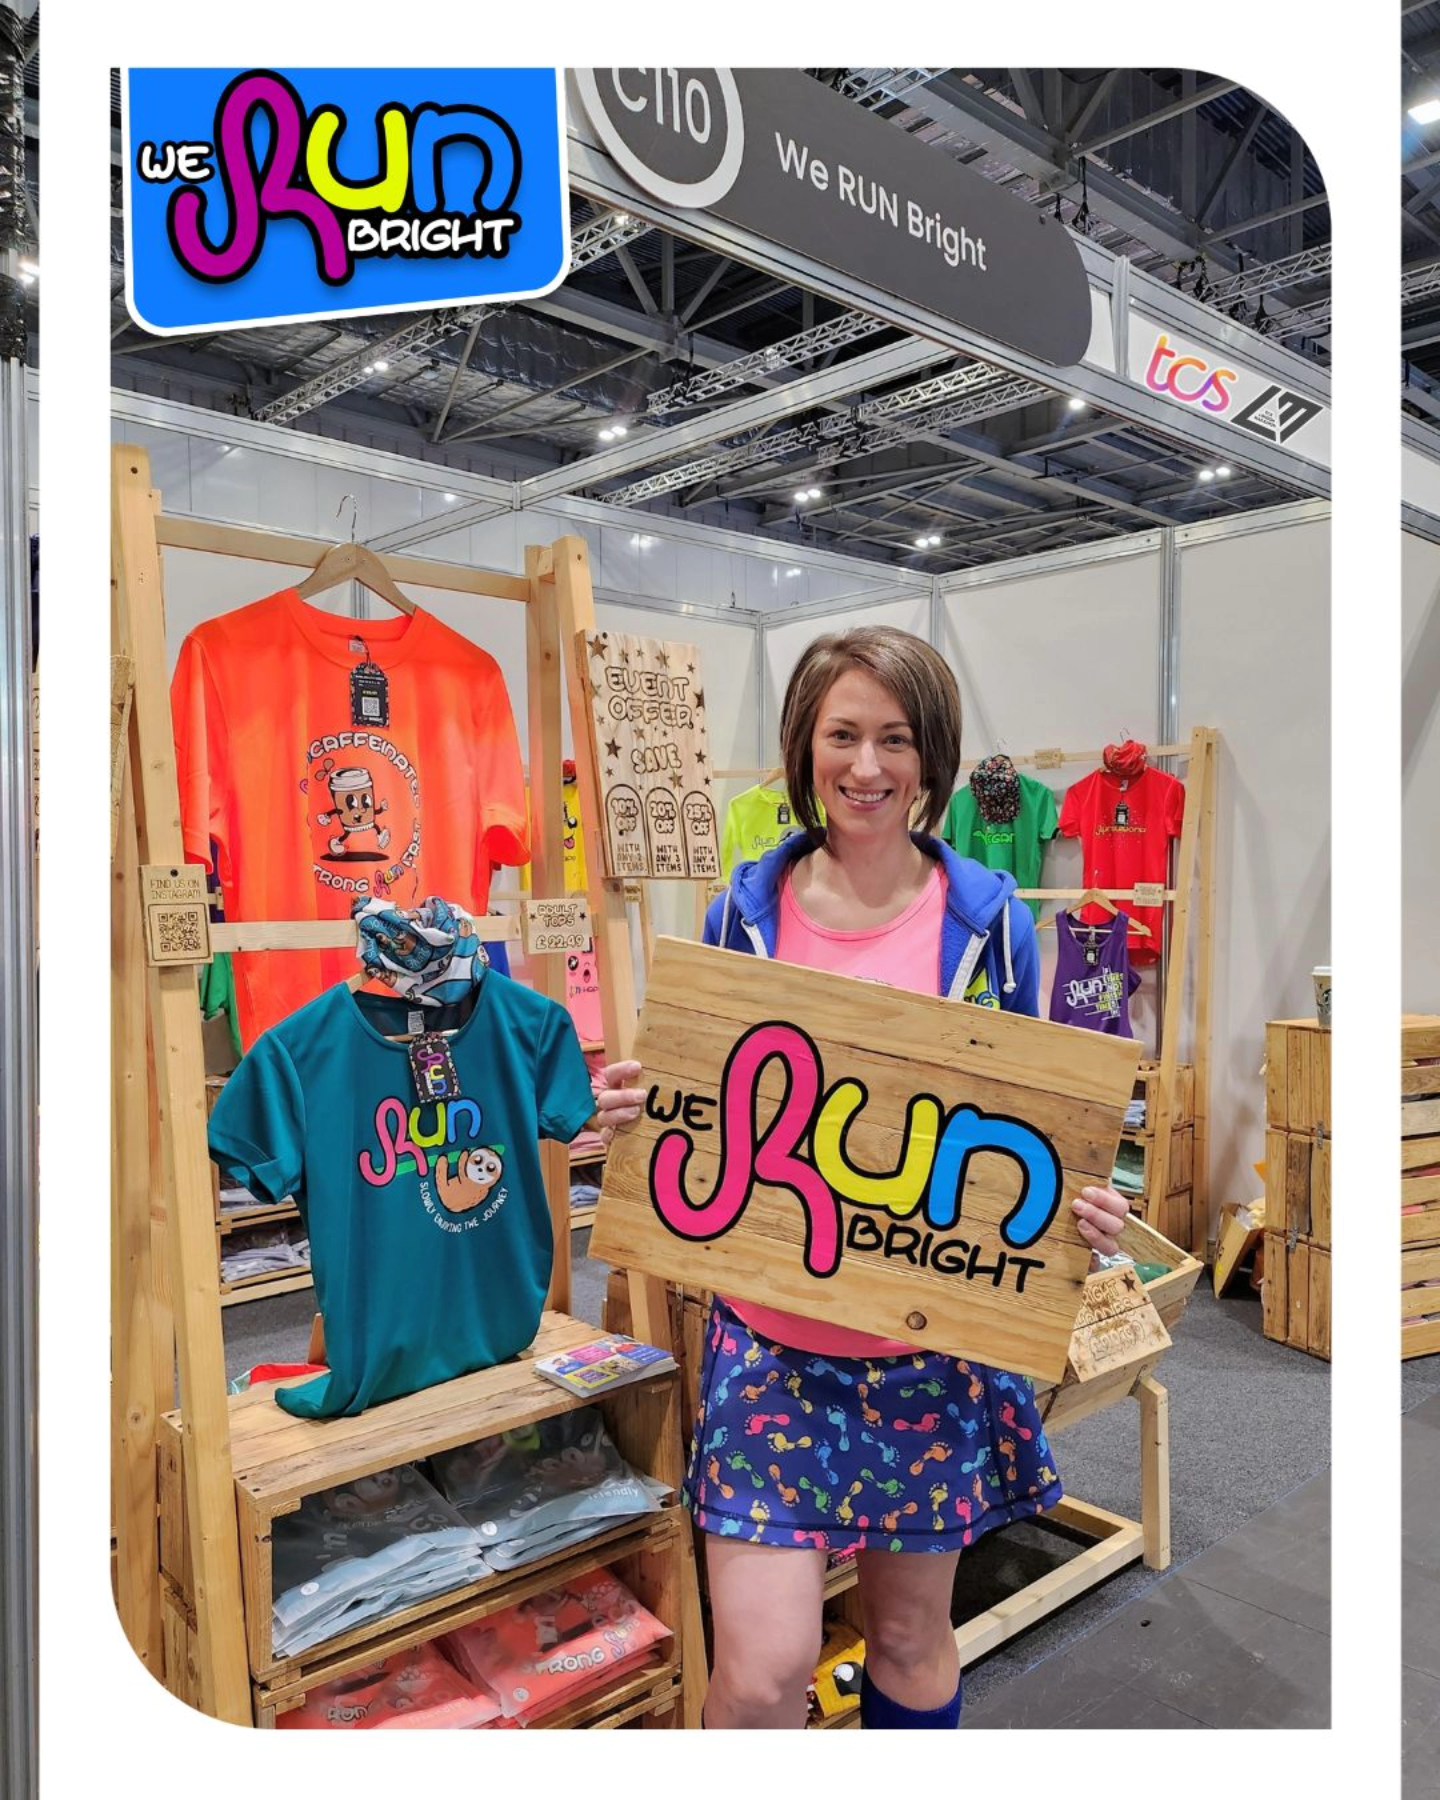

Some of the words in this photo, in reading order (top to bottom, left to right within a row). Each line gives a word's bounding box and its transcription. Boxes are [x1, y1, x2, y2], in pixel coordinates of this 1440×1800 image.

[611, 68, 712, 144] C110
[775, 131, 829, 191] We
[838, 164, 899, 228] RUN
[907, 200, 987, 272] Bright
[1146, 335, 1237, 412] tcs
[605, 666, 690, 701] EVENT
[608, 695, 695, 730] OFFER
[631, 743, 682, 775] SAVE
[610, 797, 639, 817] 10%
[649, 801, 676, 820] 20%
[685, 804, 712, 822] 25%
[617, 843, 640, 852] WITH
[656, 845, 678, 854] WITH
[693, 846, 713, 855] WITH
[312, 864, 369, 893] TRONG
[656, 863, 682, 873] ITEMS
[692, 864, 717, 873] ITEMS
[150, 880, 172, 890] FIND
[175, 880, 186, 889] US
[188, 880, 200, 889] ON
[151, 889, 201, 900] INSTAGRAM
[543, 914, 576, 928] TOPS
[646, 1084, 717, 1132] WE
[419, 1181, 437, 1215] SLOWLY
[464, 1216, 480, 1231] THE
[482, 1186, 510, 1223] JOURNEY
[846, 1213, 1046, 1294] BRIGHT
[1081, 1277, 1120, 1305] RIGHT
[588, 1486, 640, 1501] riendly
